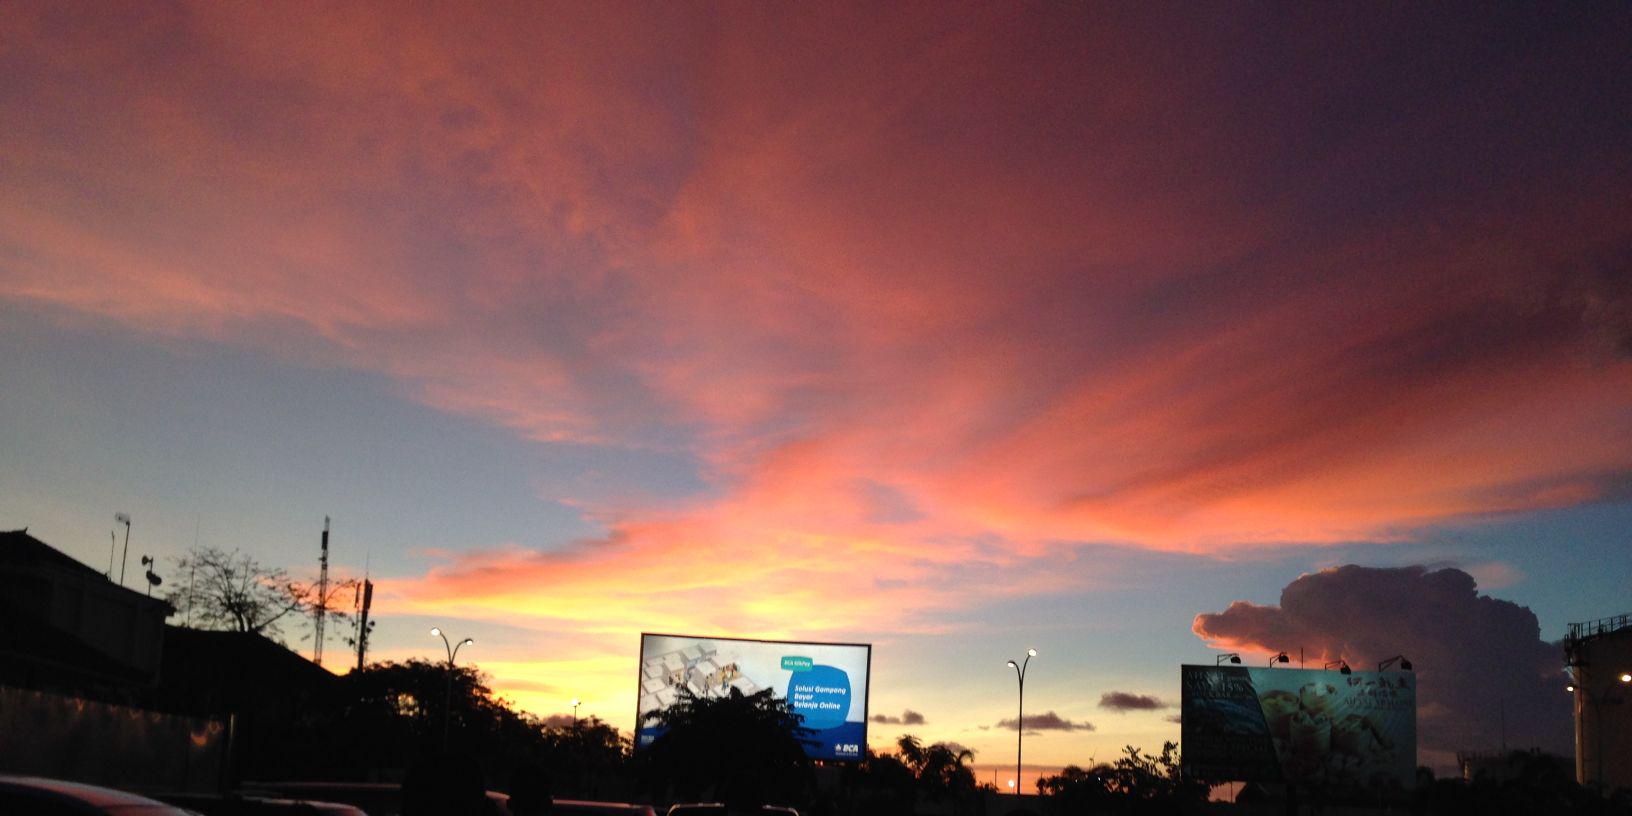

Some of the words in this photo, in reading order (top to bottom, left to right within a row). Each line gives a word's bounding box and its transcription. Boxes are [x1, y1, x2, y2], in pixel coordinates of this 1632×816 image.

[794, 685, 814, 693] Solusi
[815, 686, 846, 695] Gampang
[794, 701, 818, 710] Belanja
[819, 702, 841, 710] Online
[843, 744, 859, 752] BCA
